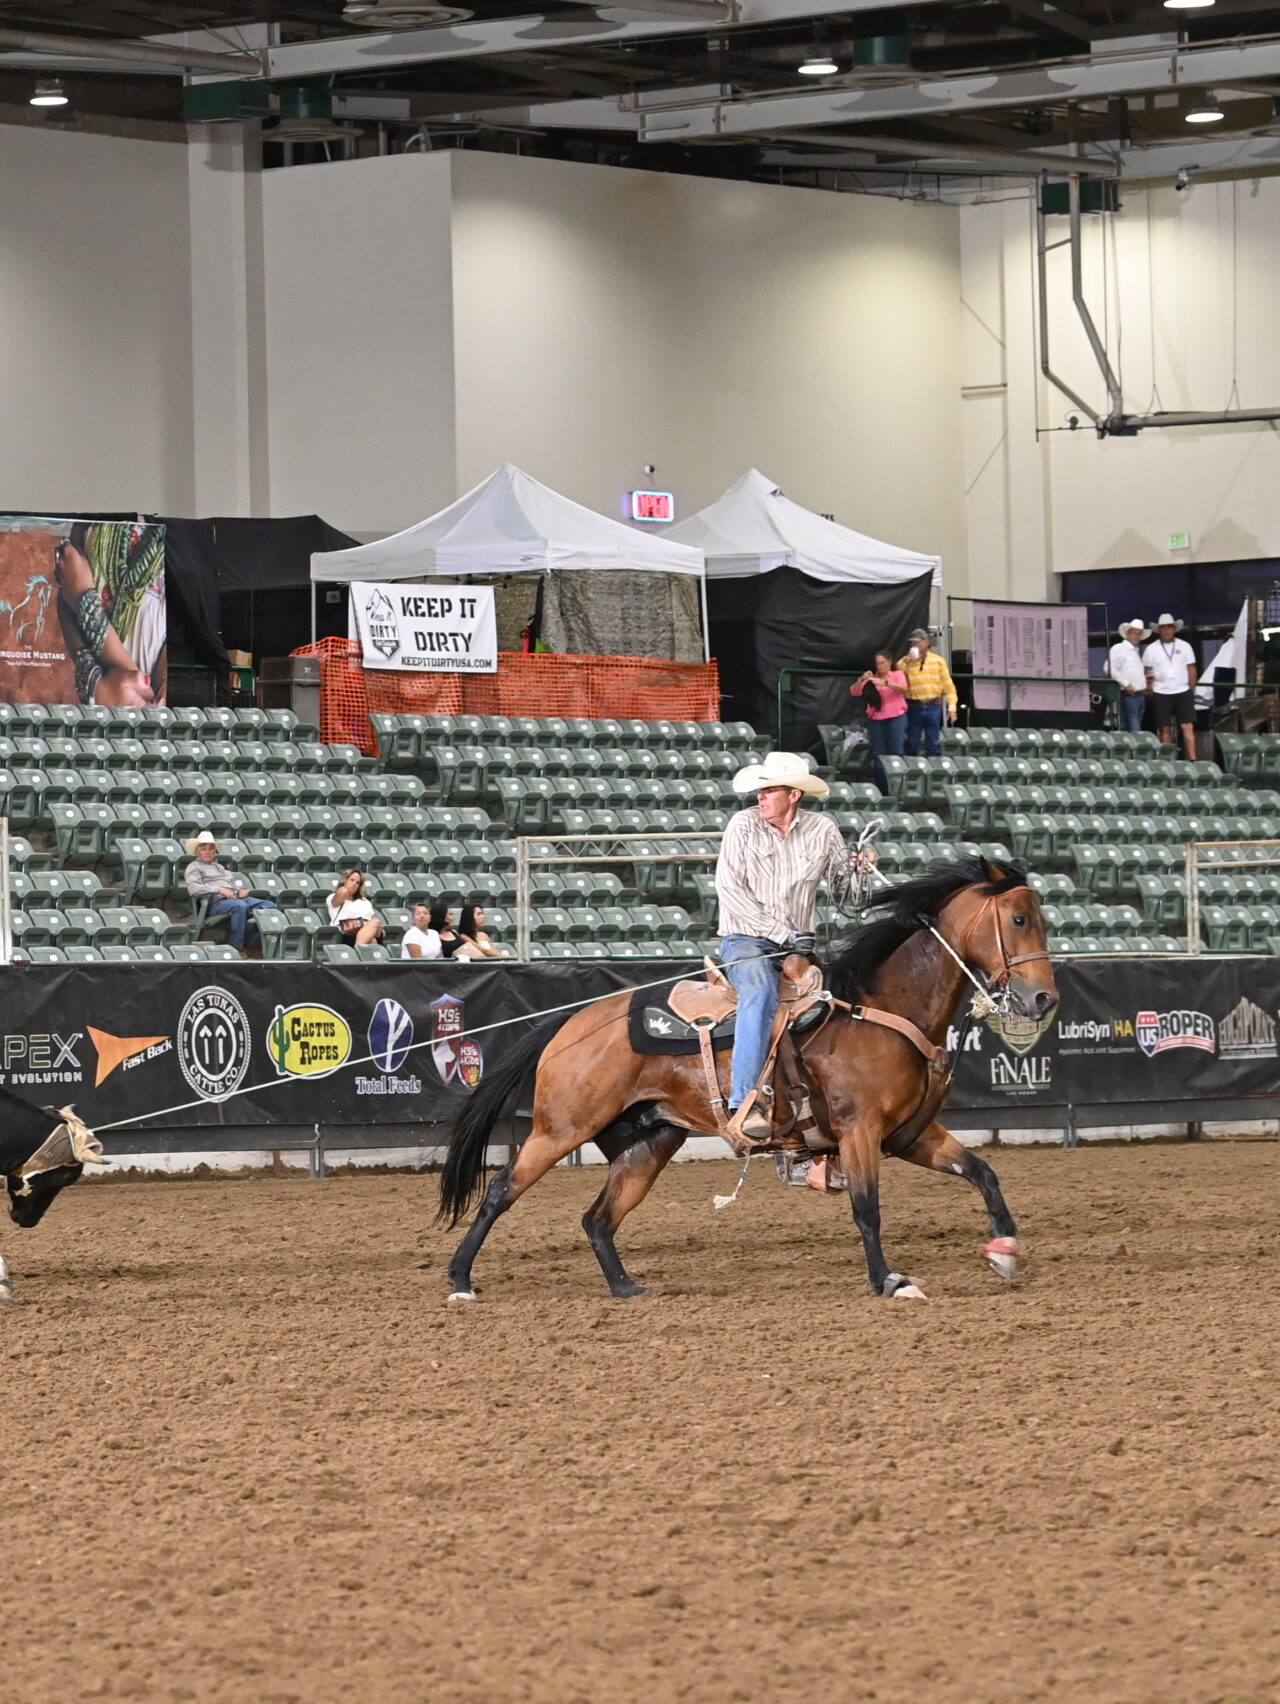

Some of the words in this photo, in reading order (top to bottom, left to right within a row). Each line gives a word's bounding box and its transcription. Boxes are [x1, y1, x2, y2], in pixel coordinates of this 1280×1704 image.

[637, 494, 669, 518] OPEN
[400, 597, 452, 618] KEEP
[460, 598, 476, 618] IT
[370, 625, 396, 638] DIRTY
[414, 631, 472, 652] DIRTY
[33, 651, 66, 660] MUSTANG
[401, 656, 492, 668] KEEPITDIRTYUSA.COM
[187, 998, 206, 1024] LAS
[206, 995, 240, 1024] TUNAS
[291, 1018, 336, 1042] CACTUS
[1058, 1020, 1110, 1042] LubriSyn
[1114, 1020, 1134, 1037] HA
[1159, 1012, 1214, 1040] ROPER
[1140, 1028, 1157, 1046] US
[122, 1052, 146, 1072] Fast
[147, 1039, 174, 1060] Back
[300, 1041, 338, 1065] ROPES
[12, 1072, 83, 1085] EVOLUTION
[355, 1075, 386, 1094] Total
[388, 1074, 422, 1094] Feeds
